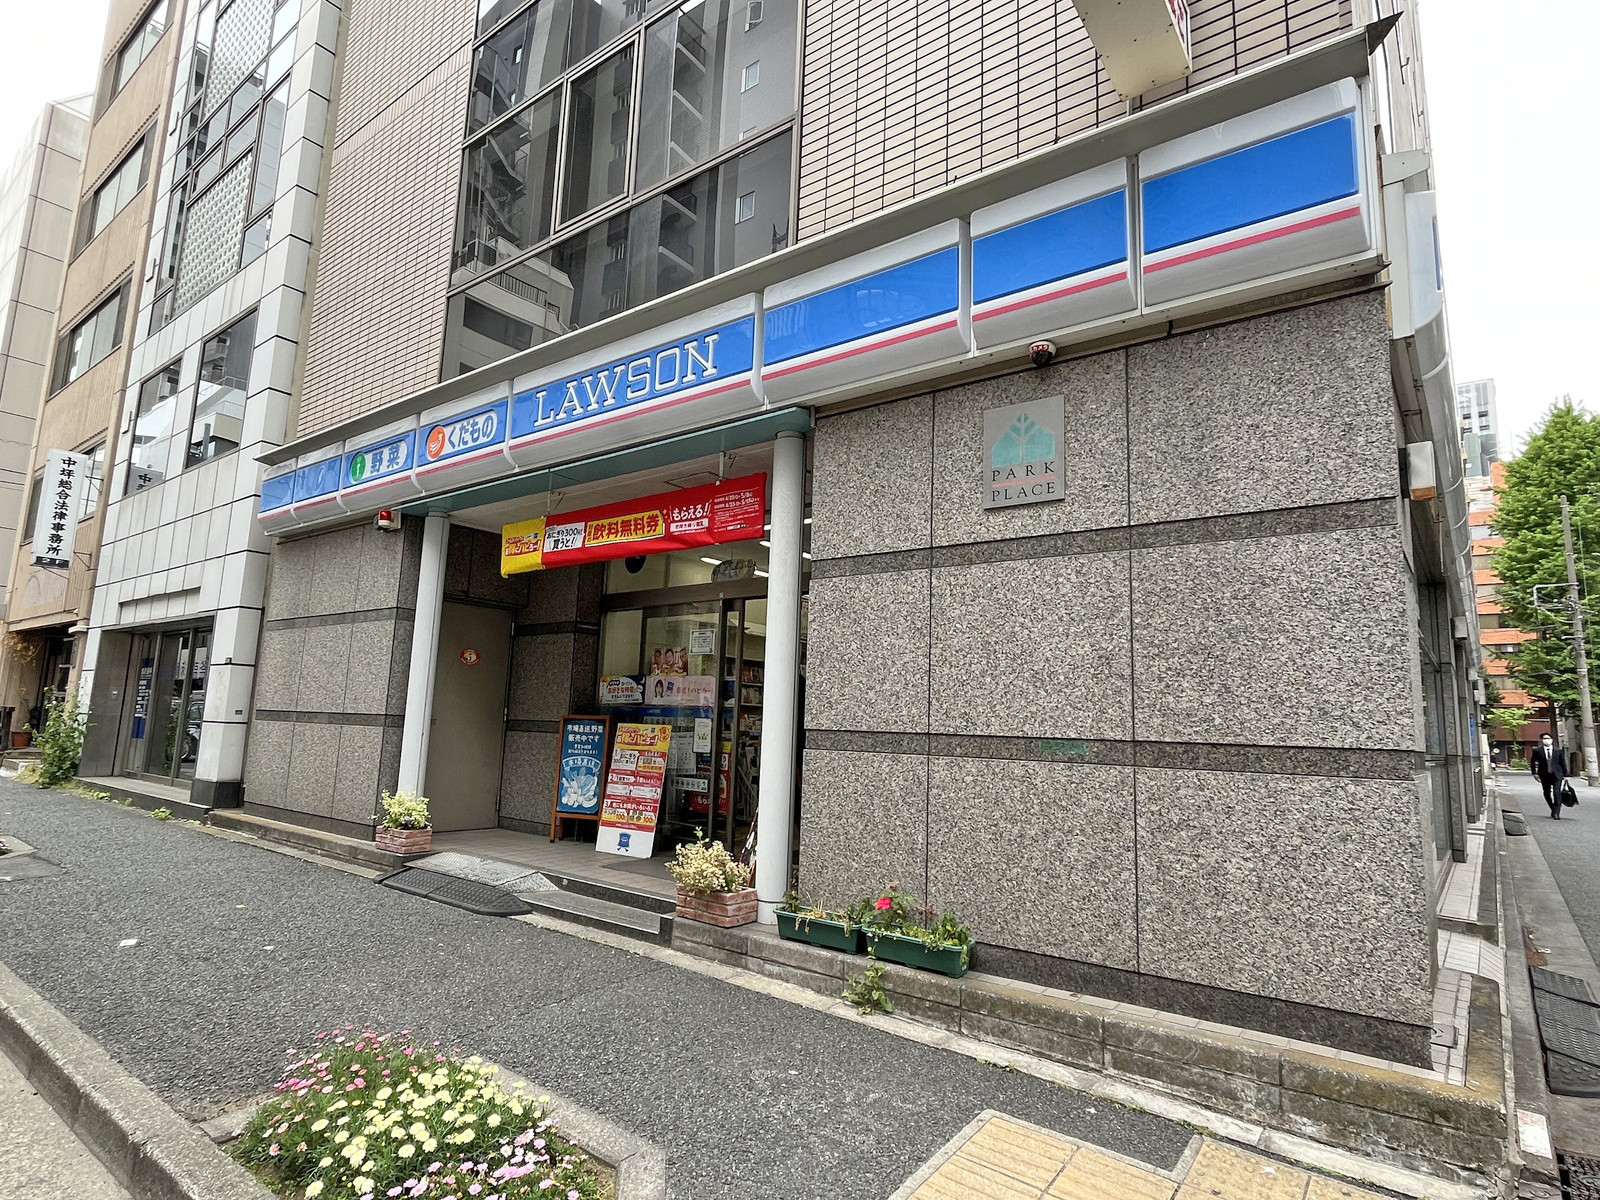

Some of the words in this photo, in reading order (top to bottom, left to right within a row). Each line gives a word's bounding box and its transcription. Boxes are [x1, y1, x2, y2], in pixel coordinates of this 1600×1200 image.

[533, 333, 720, 428] LAWSON
[447, 414, 494, 450] くだもの
[370, 444, 401, 475] 野菜
[992, 461, 1055, 482] PARK
[992, 482, 1056, 502] PLACE
[46, 456, 78, 557] 中坪総合法律事務所
[592, 513, 659, 541] 飲料無料券
[566, 724, 603, 733] 市場直送野菜
[568, 734, 600, 743] 販売中です
